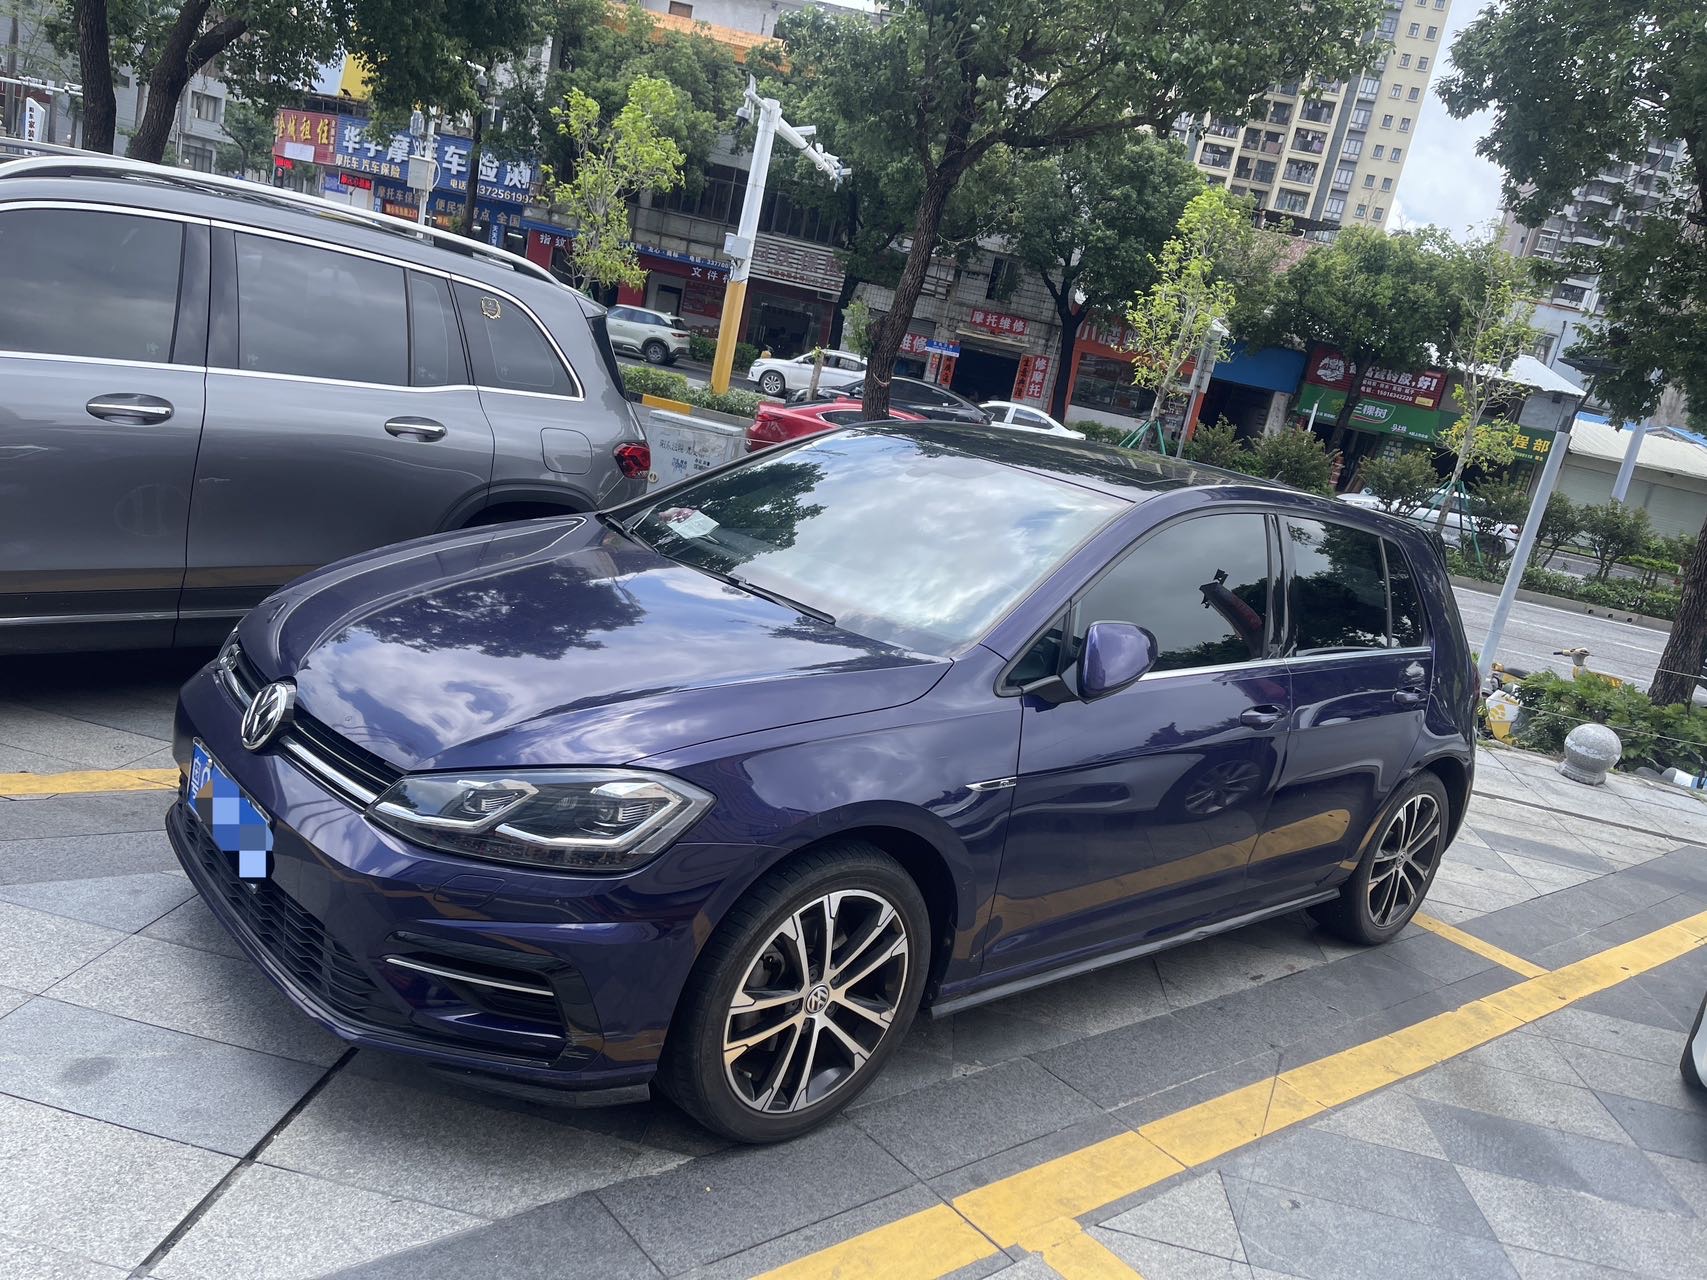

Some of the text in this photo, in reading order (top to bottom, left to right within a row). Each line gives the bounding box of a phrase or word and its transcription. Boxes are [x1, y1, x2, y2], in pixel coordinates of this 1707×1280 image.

[971, 311, 1026, 333] 摩托维修
[1028, 357, 1047, 397] 修摩托
[1353, 403, 1388, 419] 三棵树
